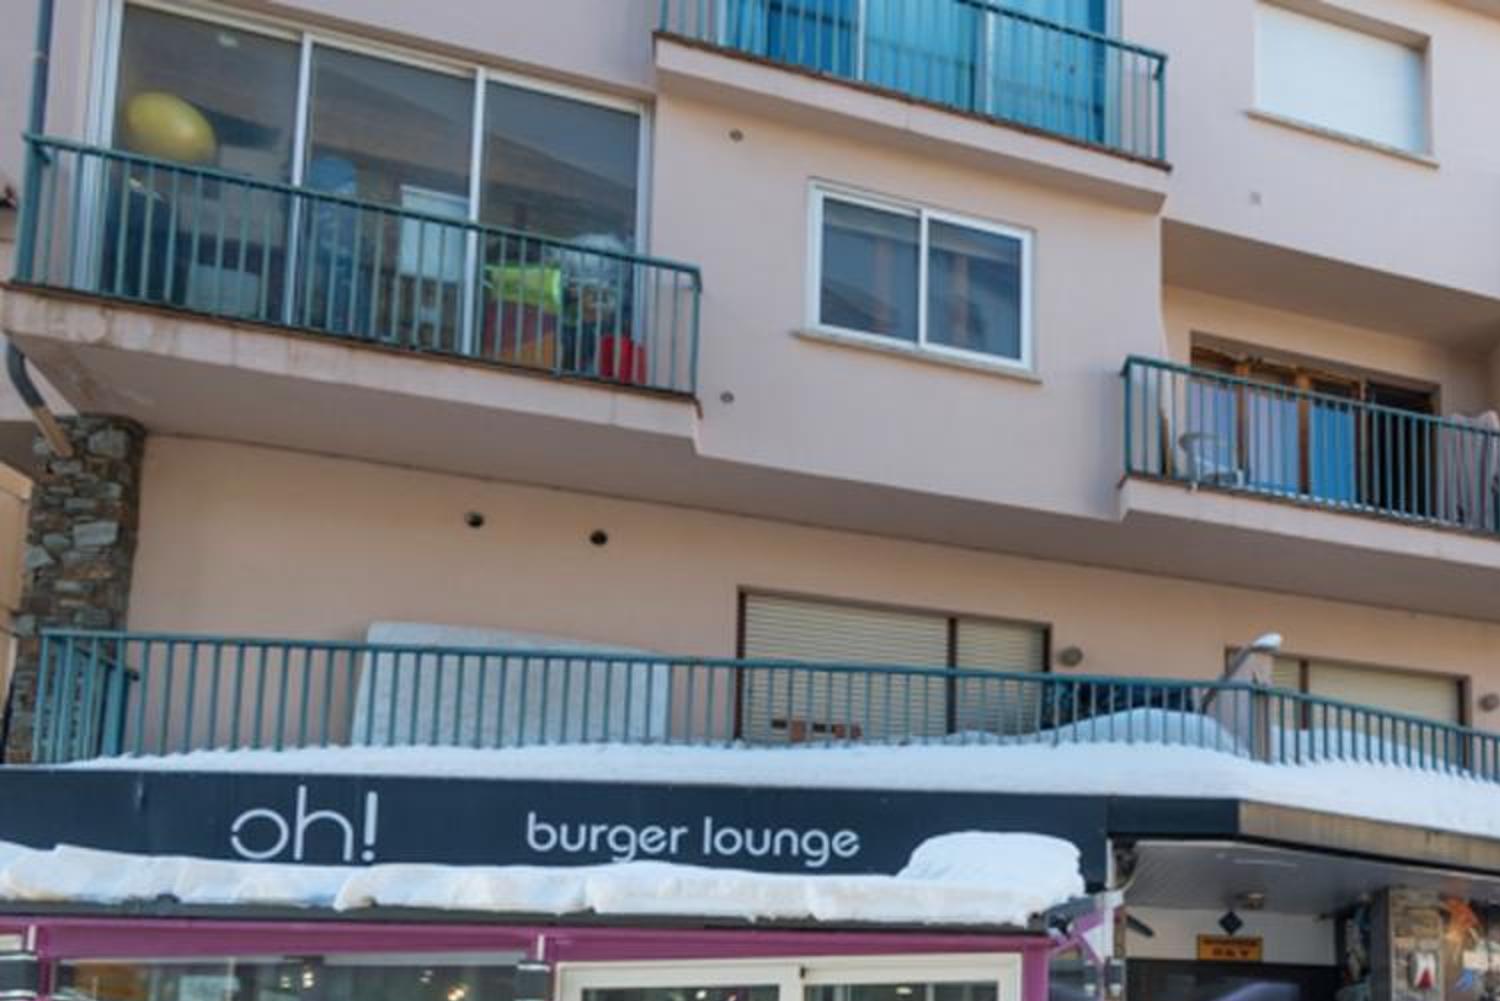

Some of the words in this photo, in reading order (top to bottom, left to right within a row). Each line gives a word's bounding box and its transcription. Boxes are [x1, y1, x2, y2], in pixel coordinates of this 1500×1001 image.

[230, 785, 378, 862] oh!
[526, 812, 688, 863] burger
[703, 816, 860, 867] lounge
